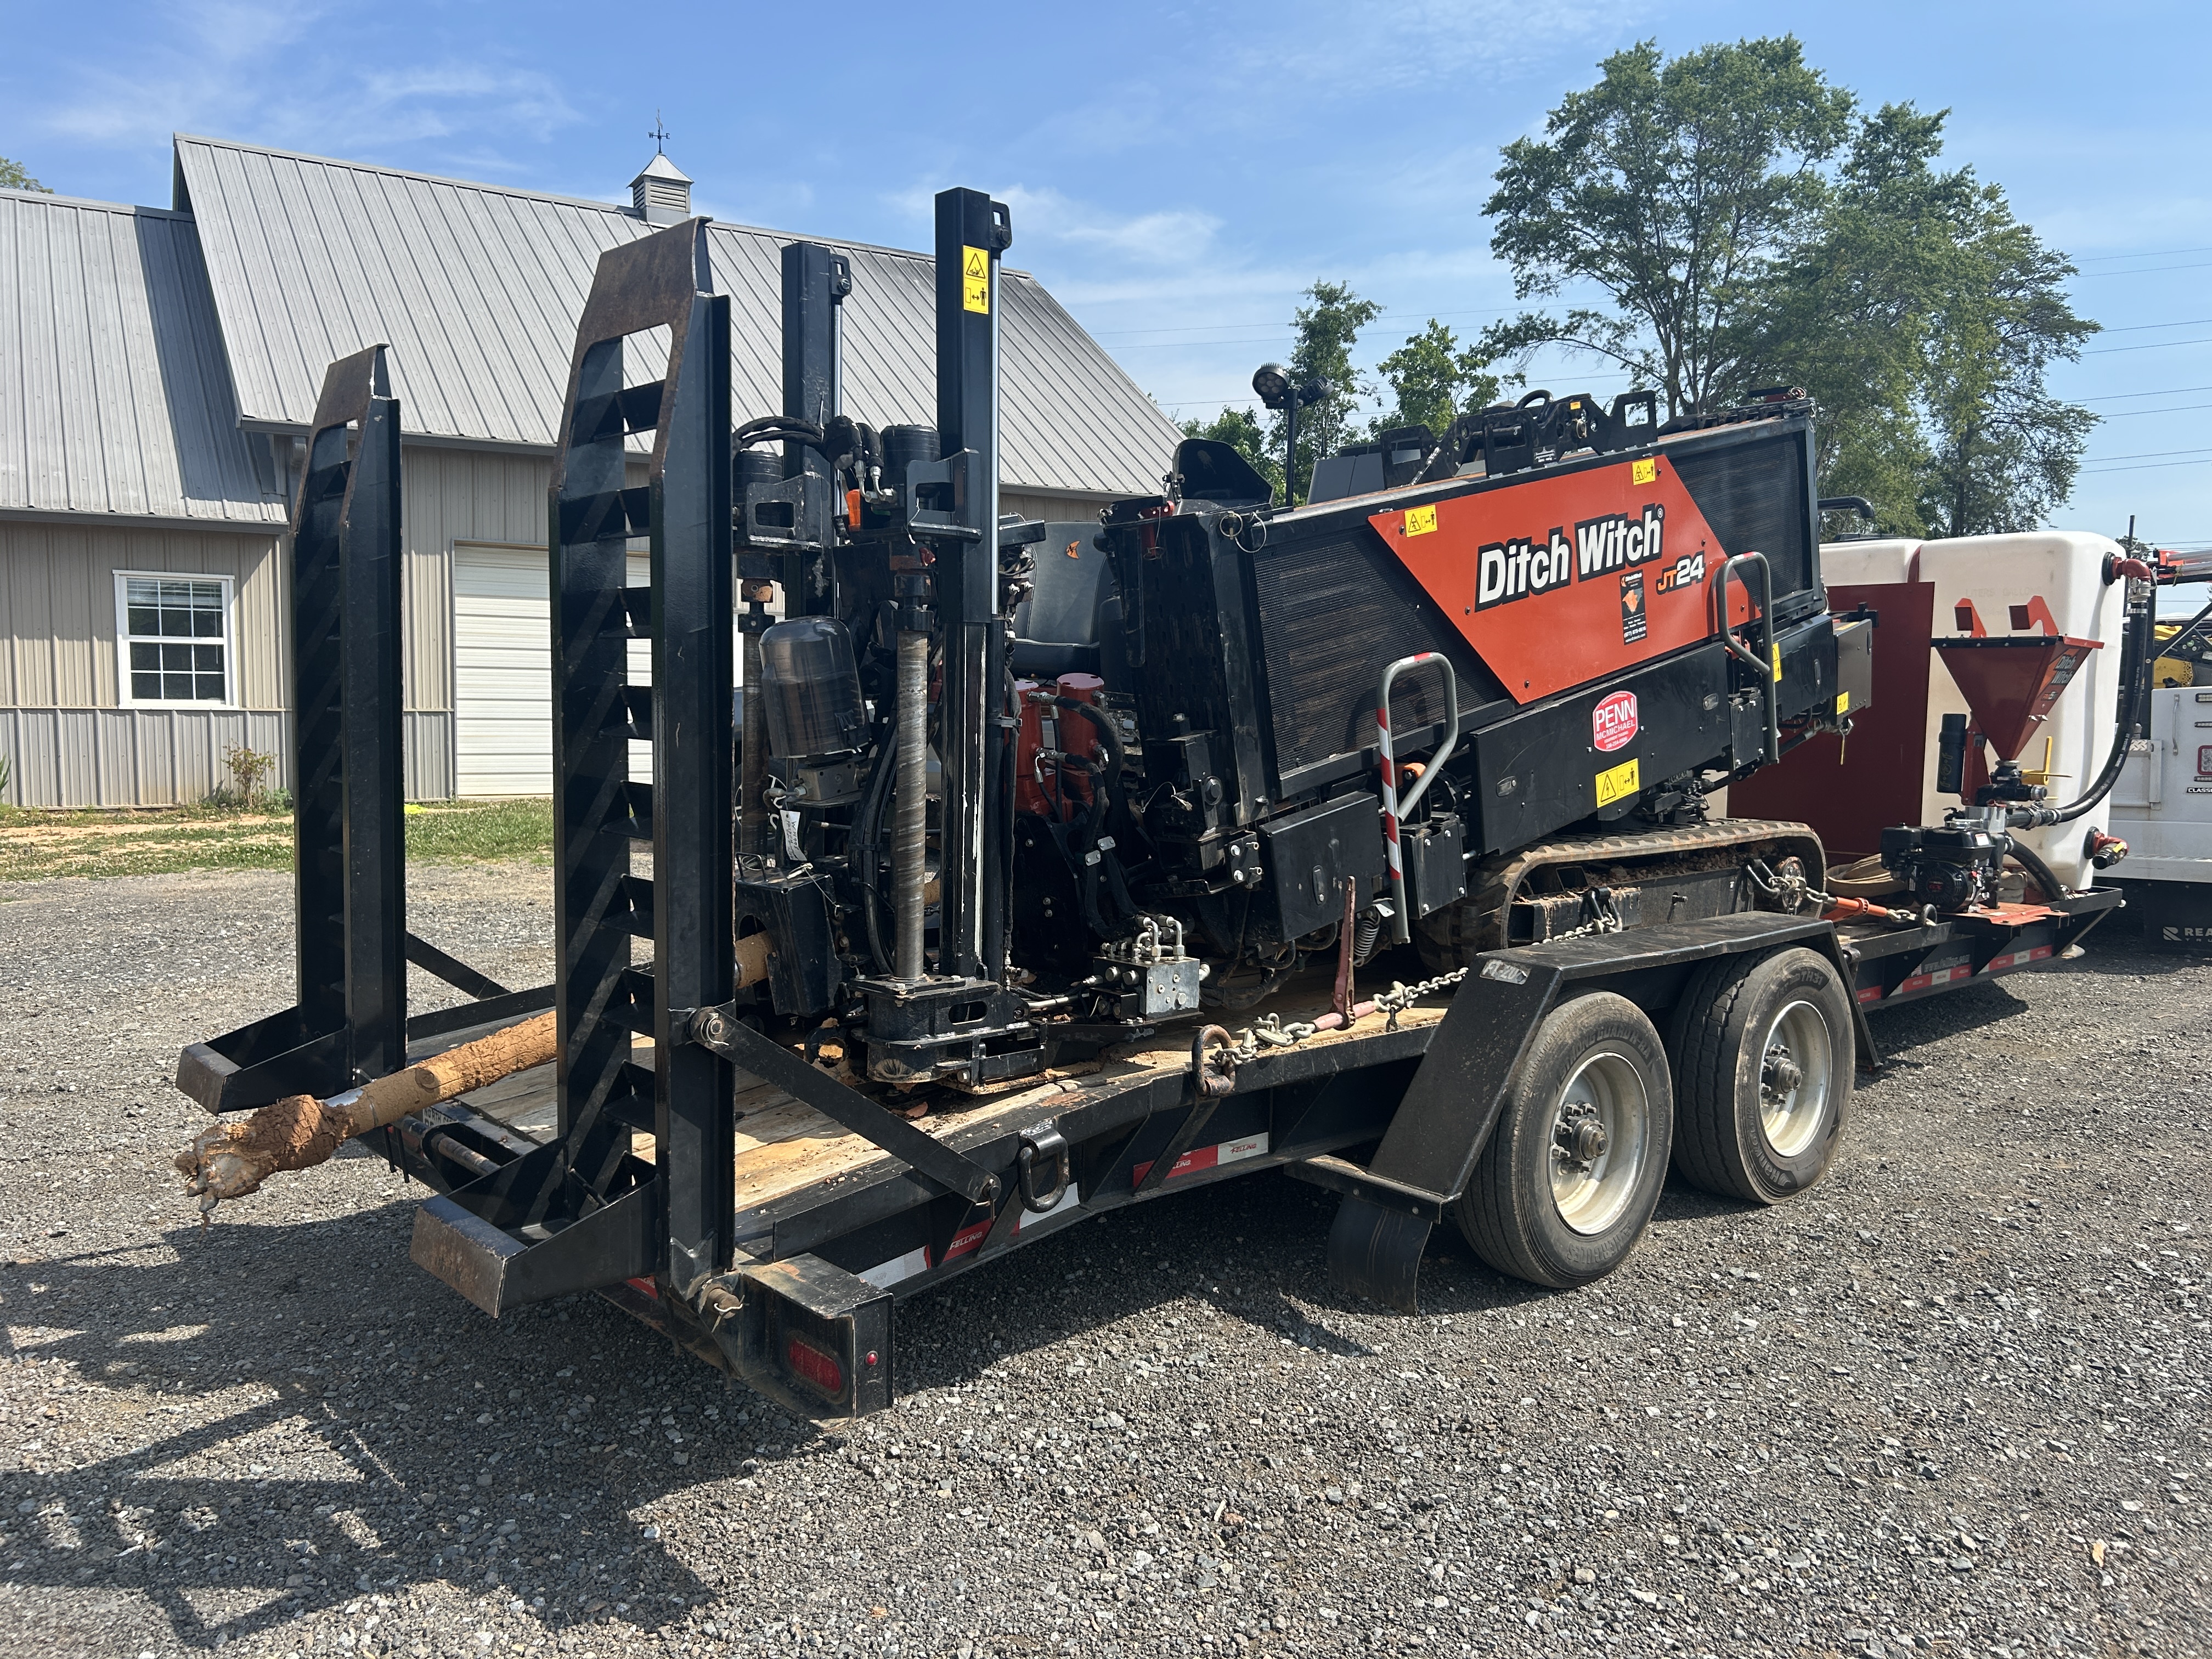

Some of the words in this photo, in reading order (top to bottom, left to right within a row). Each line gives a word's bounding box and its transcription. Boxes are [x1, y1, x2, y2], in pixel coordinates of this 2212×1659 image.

[1479, 534, 1568, 604] Ditch
[1657, 555, 1704, 591] JT24
[2055, 656, 2076, 669] Ditch
[2051, 670, 2073, 684] Witch
[1595, 697, 1635, 732] PENN
[1596, 720, 1636, 741] MCMICHAEL
[424, 1108, 441, 1124] NORTH
[1230, 1143, 1257, 1154] FELLING
[1746, 1105, 1780, 1183] Hankook
[949, 1232, 983, 1251] FELLING
[1567, 1234, 1622, 1265] HERCULES
